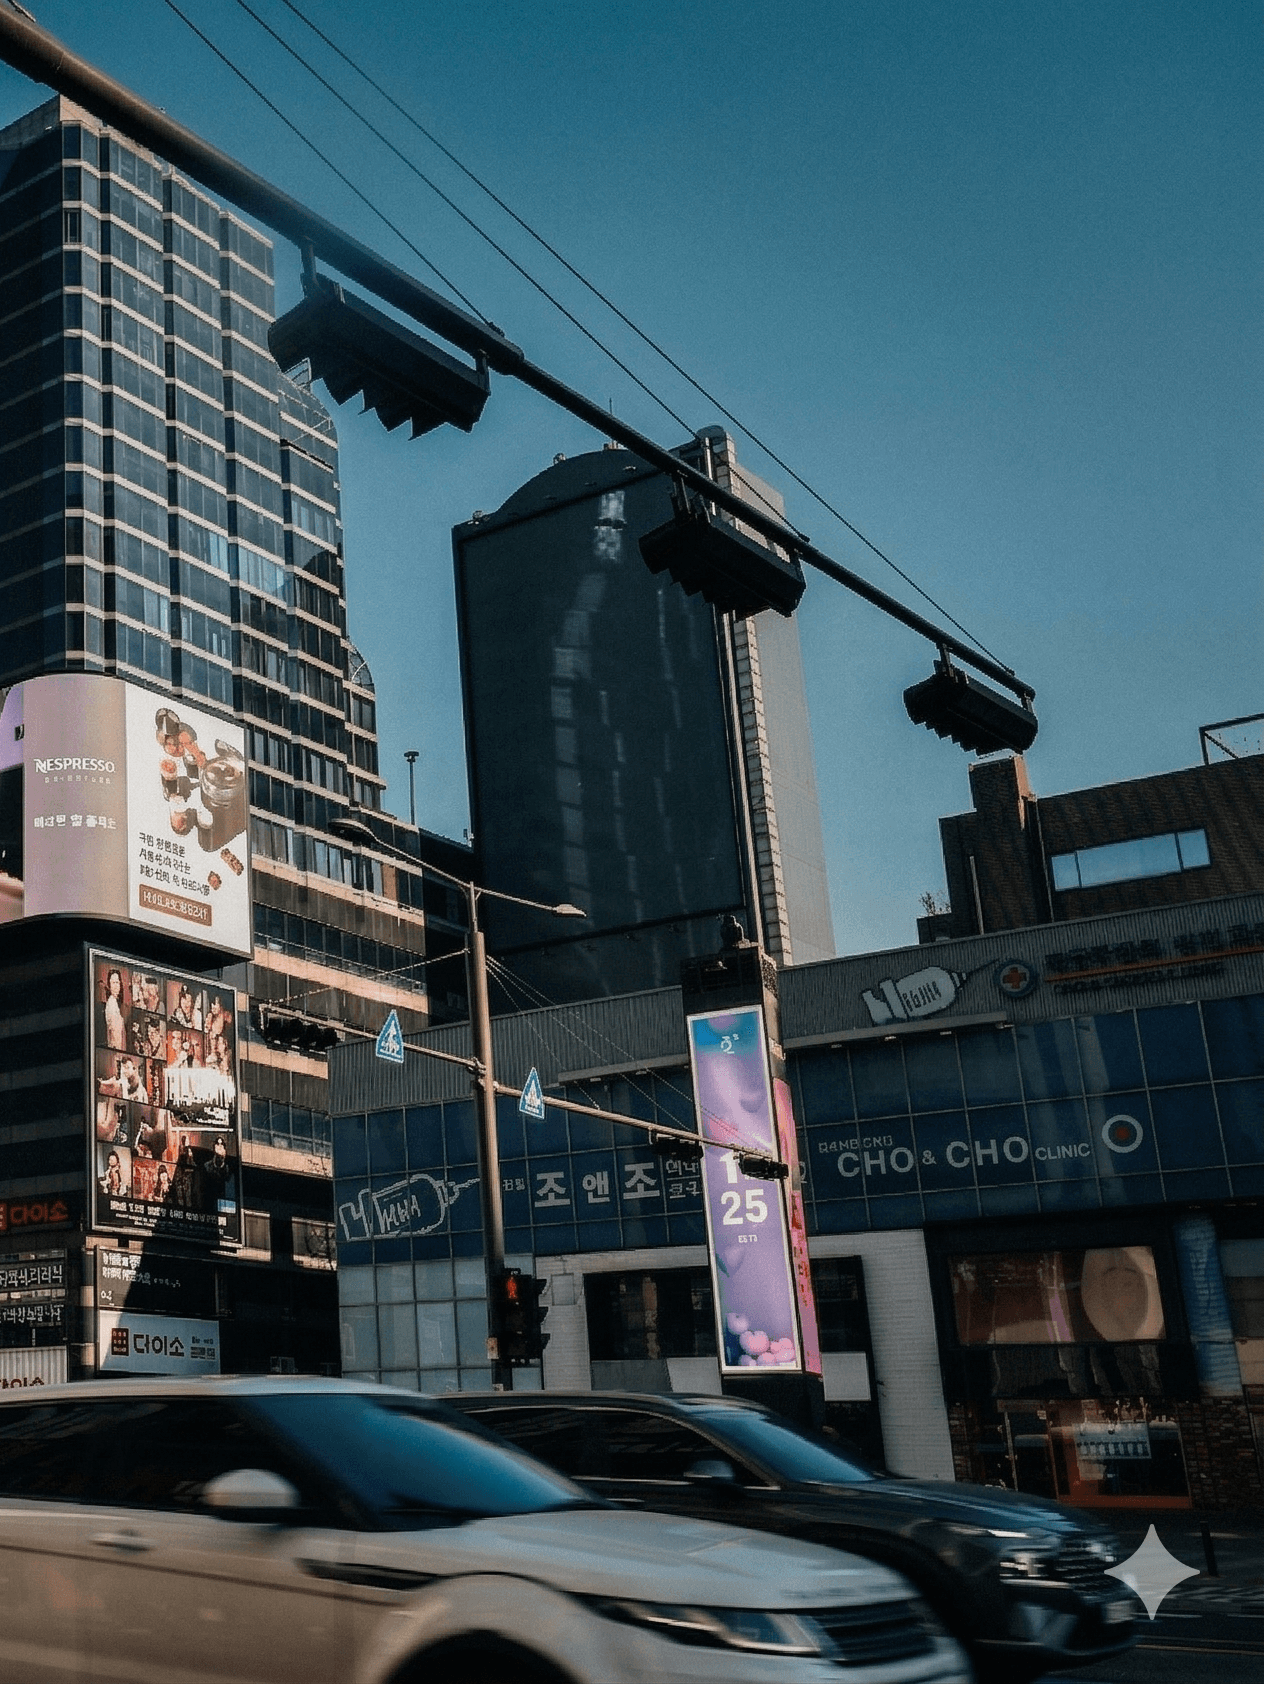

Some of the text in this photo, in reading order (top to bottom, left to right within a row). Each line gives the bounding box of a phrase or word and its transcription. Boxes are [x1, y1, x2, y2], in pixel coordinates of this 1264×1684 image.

[34, 757, 115, 774] NESPRESSO
[837, 1136, 1091, 1178] CHO & CHO CLINIC
[10, 1200, 68, 1224] 다이소
[721, 1189, 768, 1225] 25
[133, 1332, 185, 1358] 다이소
